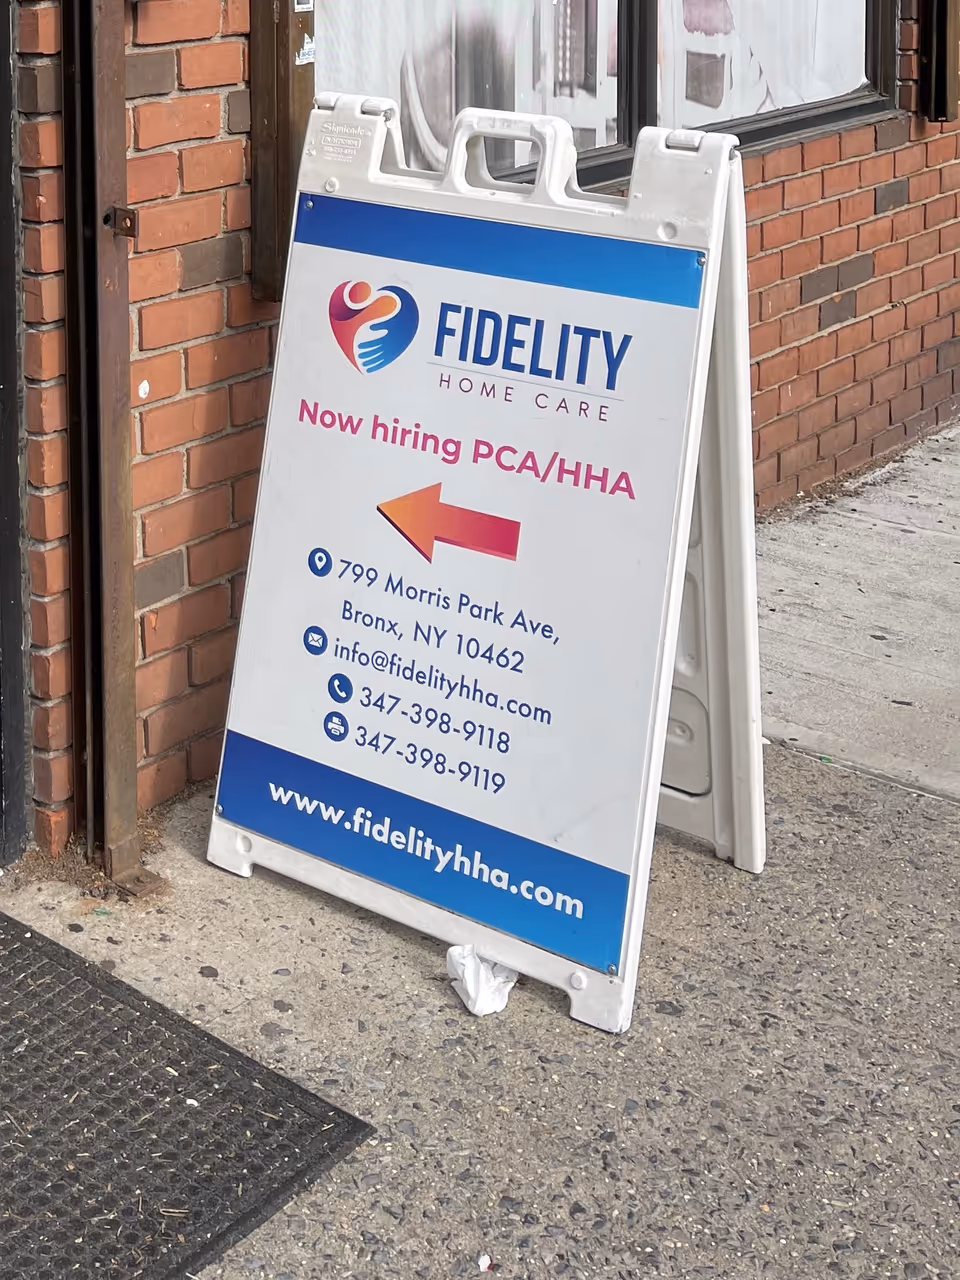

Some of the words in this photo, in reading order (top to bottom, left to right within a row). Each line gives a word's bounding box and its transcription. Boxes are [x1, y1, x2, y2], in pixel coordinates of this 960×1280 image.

[434, 302, 634, 392] FIDELITY
[439, 373, 516, 403] HOME
[535, 393, 610, 423] CARE
[298, 398, 364, 436] Now
[371, 414, 463, 464] hiring
[473, 441, 636, 500] PCA/HHA
[338, 559, 379, 588] 799
[385, 574, 451, 610] Morris
[458, 594, 504, 626] Park
[511, 610, 561, 644] Ave,
[341, 600, 403, 641] Bronx,
[414, 622, 448, 649] NY
[457, 634, 525, 674] 10462
[334, 638, 552, 724] info@fidelityhha.com
[360, 686, 511, 754] 347-398-9118
[355, 725, 506, 794] 347-398-9119
[268, 782, 585, 919] www.fidelityhha.com
